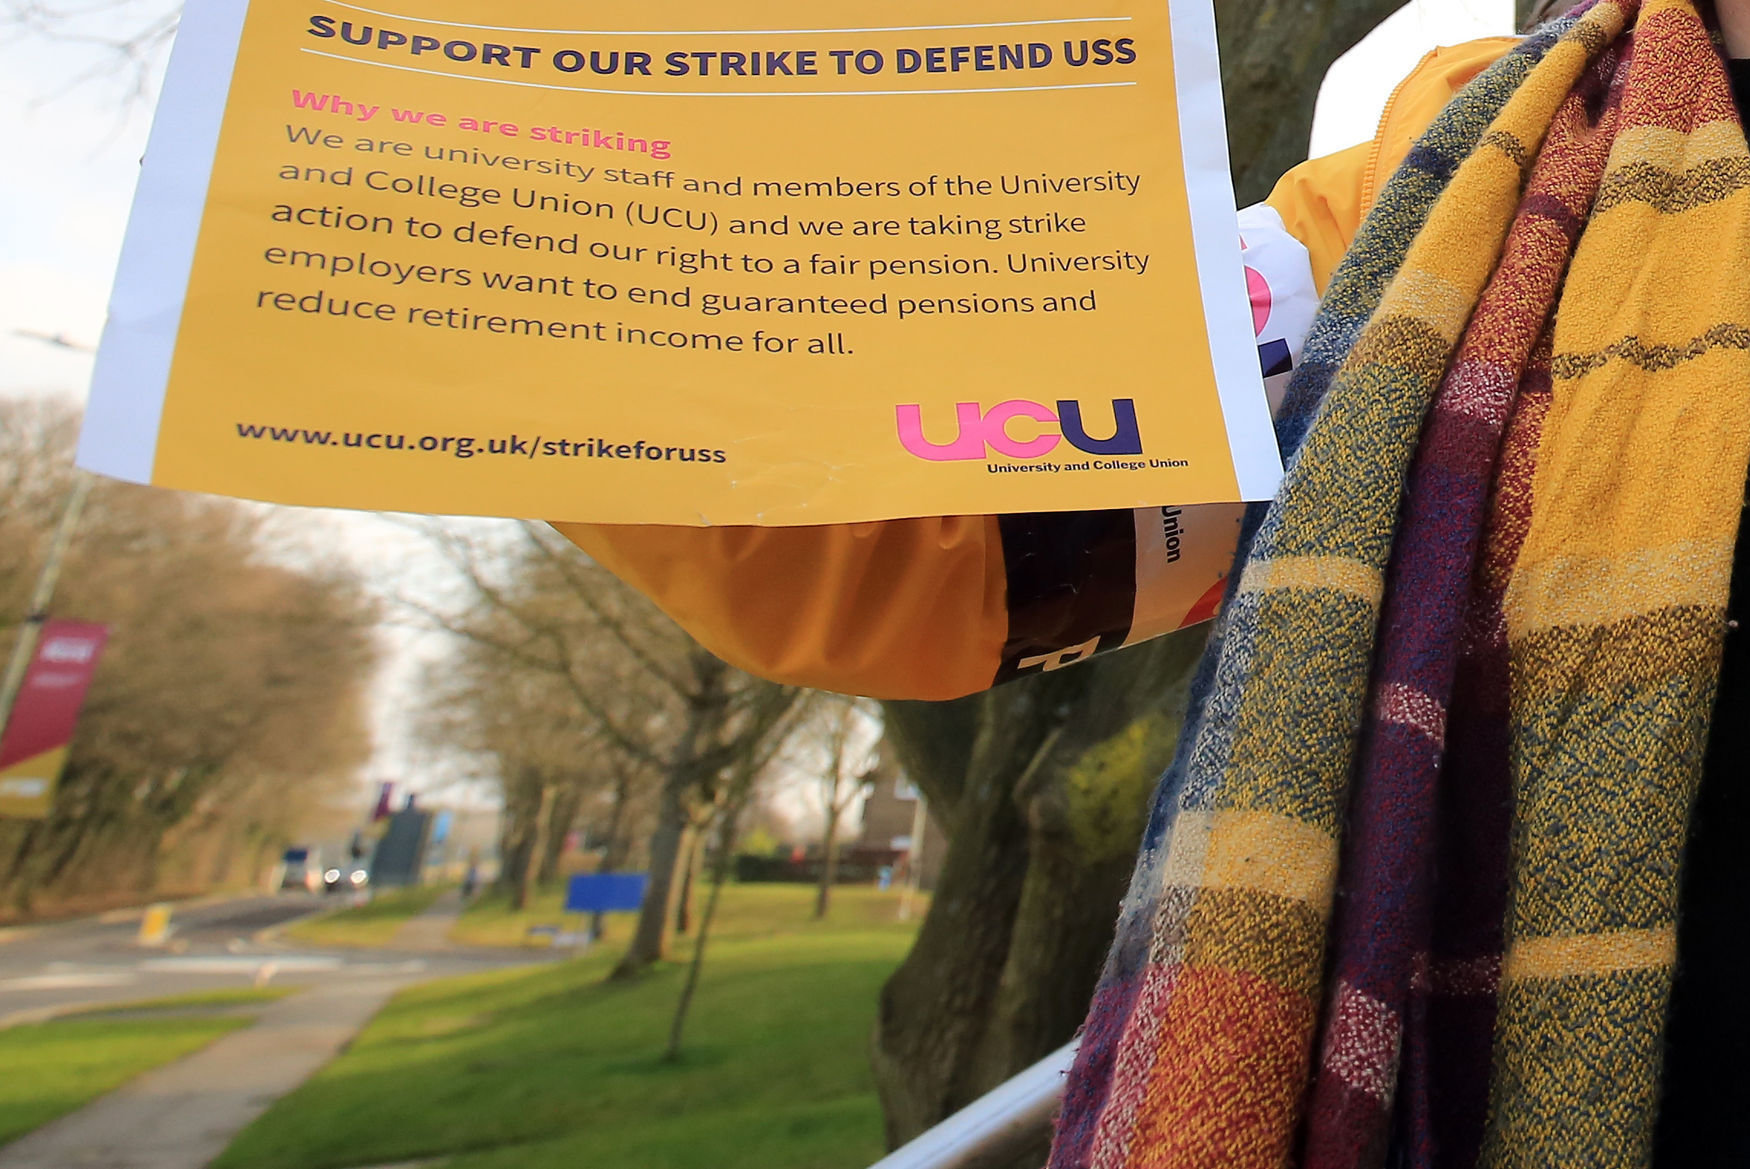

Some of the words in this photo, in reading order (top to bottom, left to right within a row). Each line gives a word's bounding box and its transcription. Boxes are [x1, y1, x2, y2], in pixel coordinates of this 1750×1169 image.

[307, 14, 541, 69] SUPPORT
[552, 49, 653, 77] OUR
[664, 50, 818, 77] STRIKE
[829, 49, 884, 76] TO
[896, 42, 1053, 74] DEFEND
[1064, 37, 1137, 67] USS
[292, 89, 380, 123] Why
[391, 107, 447, 127] we
[458, 116, 520, 137] are
[529, 125, 672, 160] striking
[286, 124, 344, 150] We
[355, 135, 413, 157] are
[424, 144, 595, 185] university
[603, 165, 675, 190] staff
[683, 175, 742, 197] and
[753, 176, 901, 197] members
[908, 174, 938, 197] of
[944, 174, 993, 197] the
[1001, 170, 1142, 197] University
[278, 165, 353, 187] and
[365, 170, 502, 209] College
[512, 187, 614, 220] Union
[625, 200, 718, 239] (UCU)
[728, 215, 789, 237] and
[798, 218, 844, 237] we
[852, 217, 901, 237] are
[908, 215, 1002, 240] taking
[1008, 212, 1087, 235] strike
[271, 203, 394, 235] action
[405, 216, 443, 240] to
[453, 220, 579, 255] defend
[588, 241, 649, 262] our
[656, 245, 734, 275] right
[741, 254, 774, 274] to
[782, 256, 801, 274] a
[808, 253, 861, 275] fair
[868, 254, 999, 281] pension.
[1007, 249, 1151, 275] University
[264, 246, 472, 286] employers
[482, 271, 575, 297] want
[583, 278, 618, 301] to
[628, 283, 693, 310] end
[701, 292, 889, 317] guaranteed
[898, 292, 1036, 320] pensions
[1042, 289, 1098, 313] and
[256, 289, 397, 321] reduce
[407, 306, 608, 343] retirement
[616, 321, 744, 352] income
[752, 330, 799, 354] for
[807, 332, 855, 356] all.
[236, 417, 728, 465] www.ucu.org.uk/strikeforuss
[986, 461, 1062, 474] University
[1064, 460, 1091, 473] and
[1093, 458, 1147, 473] College
[1148, 456, 1190, 470] Union
